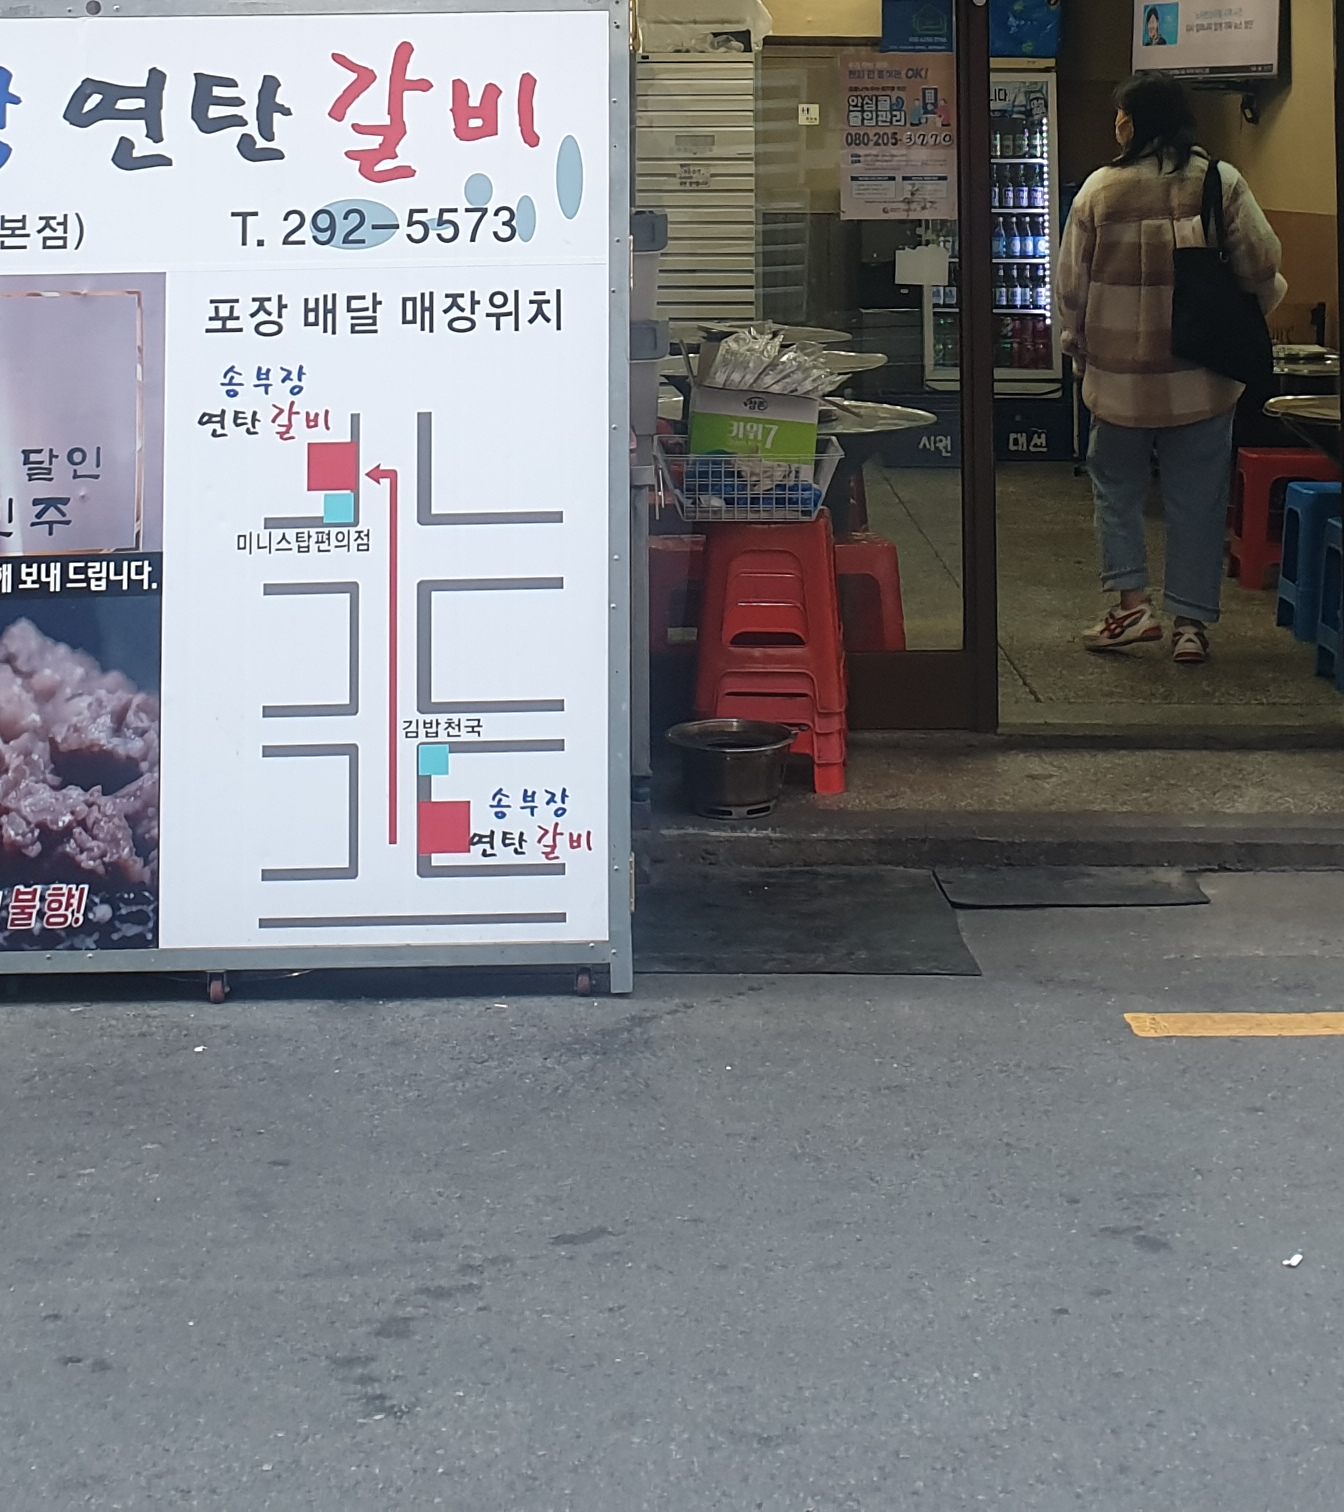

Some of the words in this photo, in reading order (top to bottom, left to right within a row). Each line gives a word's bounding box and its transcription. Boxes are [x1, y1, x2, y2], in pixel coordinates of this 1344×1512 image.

[905, 67, 929, 80] OK!
[61, 67, 292, 170] 연탄
[328, 41, 541, 183] 갈비
[845, 132, 953, 146] 080-205-3770
[231, 211, 265, 247] T.
[282, 206, 518, 248] 292-5573
[205, 294, 288, 337] 포장
[303, 292, 383, 335] 배달
[402, 289, 563, 333] 매장위치
[220, 365, 307, 398] 송부장
[198, 409, 260, 438] 연탄
[270, 400, 331, 440] 갈비
[919, 434, 952, 458] 시원
[1009, 428, 1048, 453] 대선
[21, 446, 102, 482] 달인
[237, 529, 371, 555] 미니스탑편의점
[18, 562, 61, 592] 보내
[66, 560, 157, 591] 드립니다.
[402, 718, 483, 739] 김밥천국
[489, 787, 569, 819] 송부장
[469, 830, 528, 857] 연탄
[537, 822, 593, 861] 갈비
